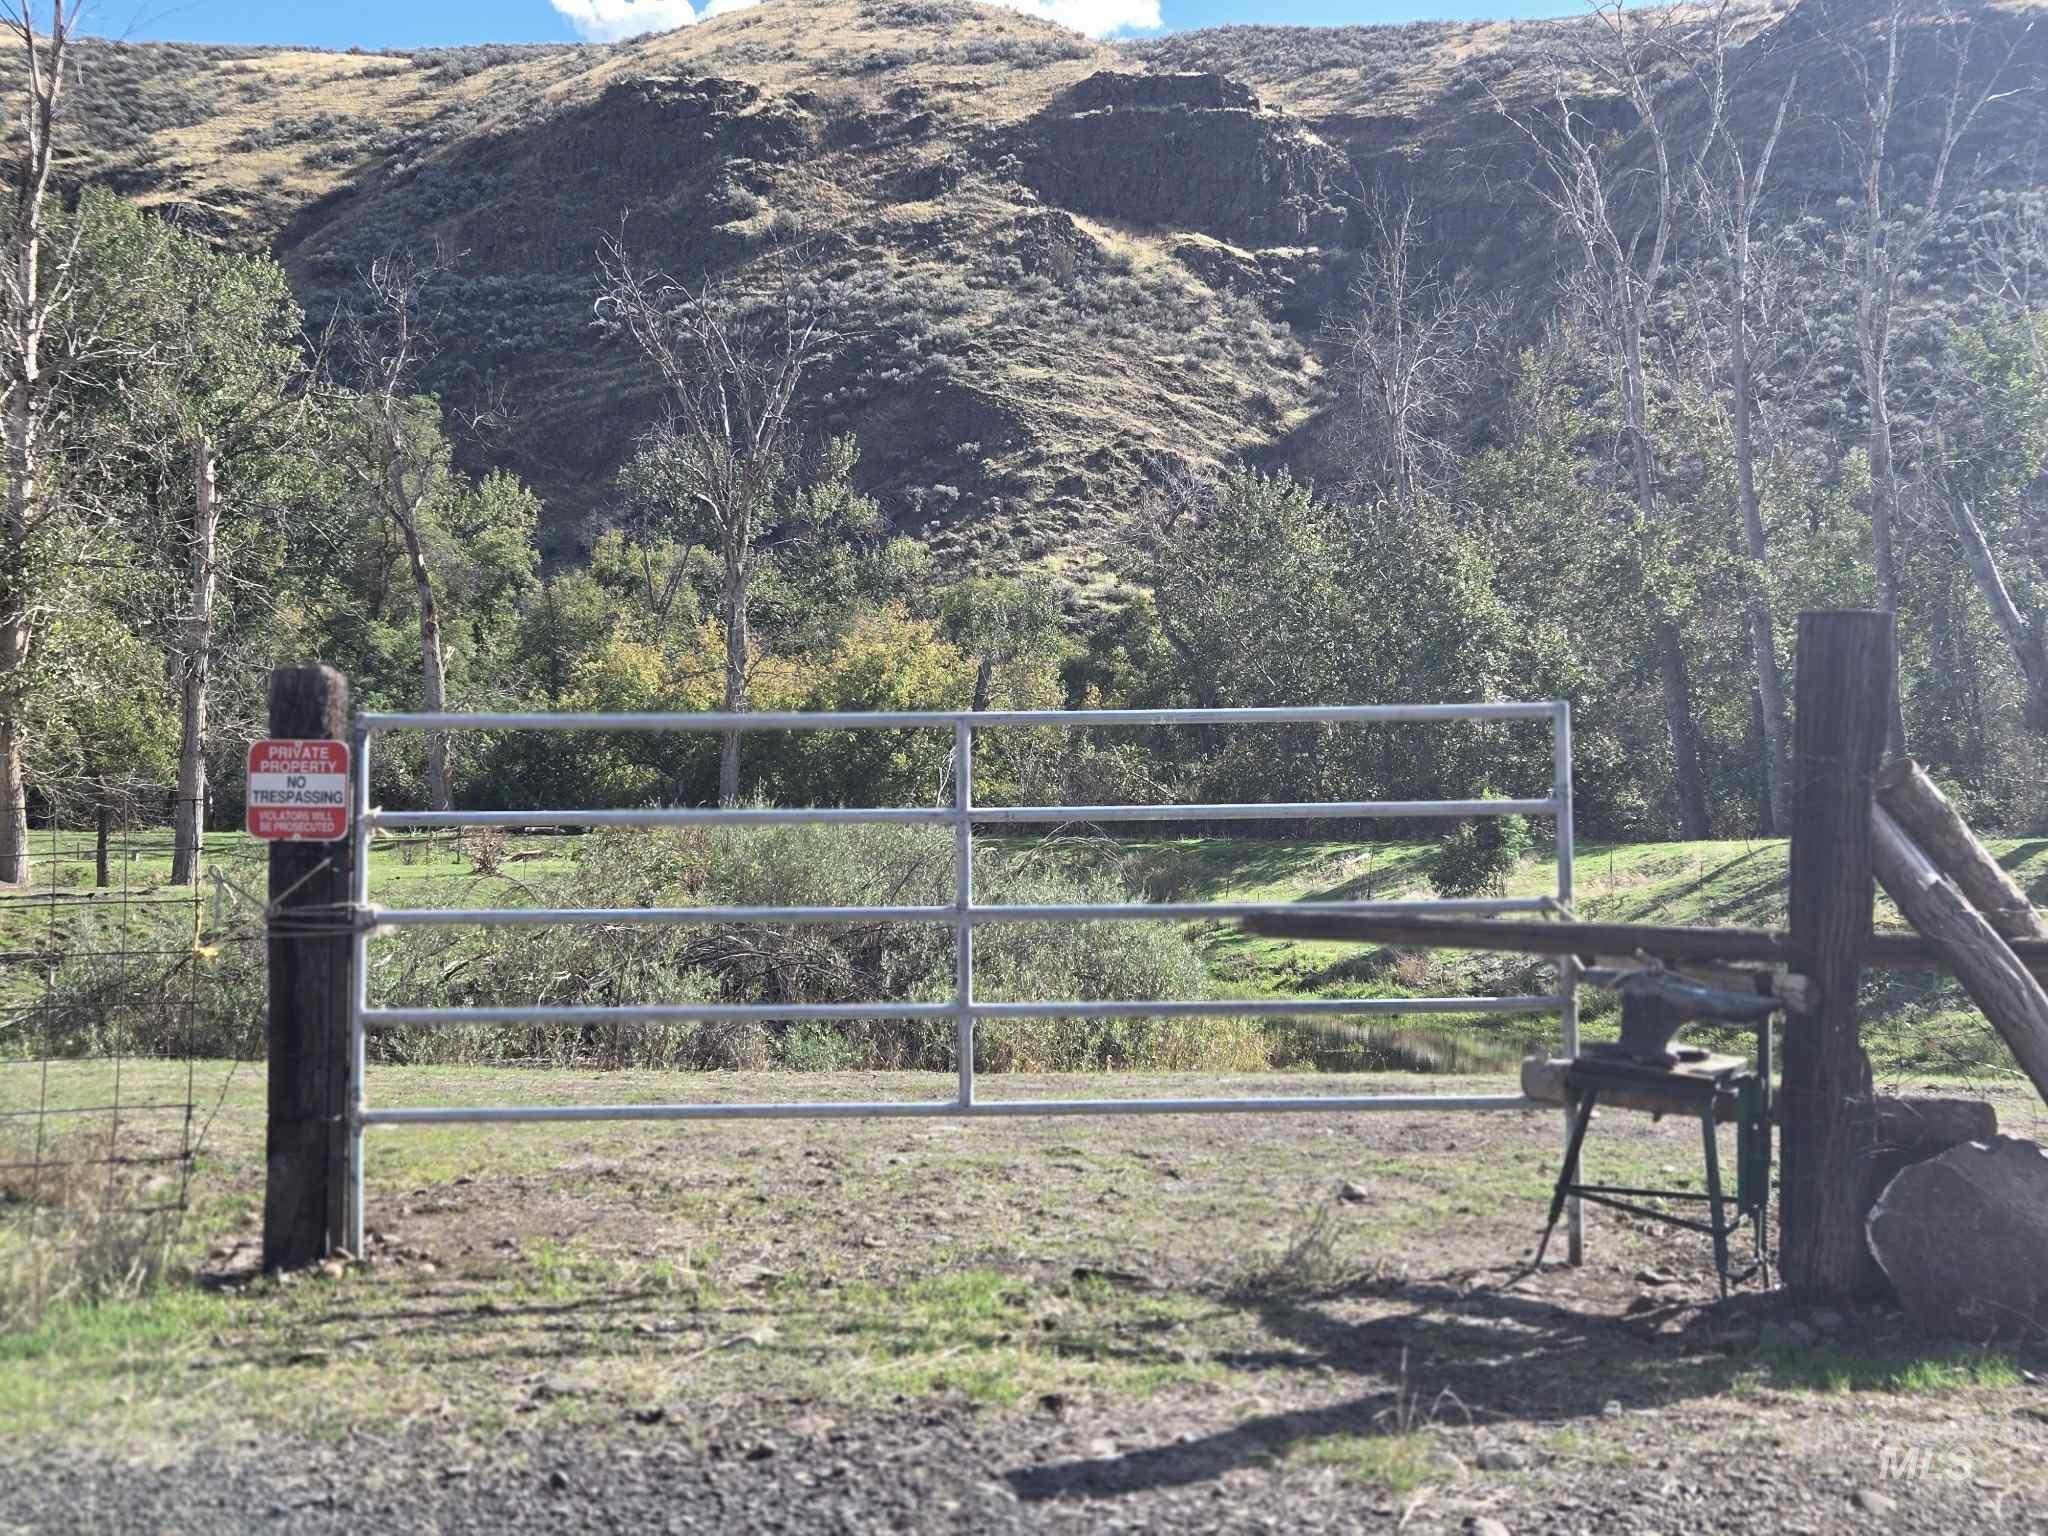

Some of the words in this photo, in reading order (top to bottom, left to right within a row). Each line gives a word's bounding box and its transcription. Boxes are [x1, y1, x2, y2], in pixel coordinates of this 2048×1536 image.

[268, 746, 329, 760] PRIVATE
[260, 760, 337, 773] PROPERTY
[287, 775, 306, 788] NO
[253, 790, 343, 804] TRESPASSING
[259, 810, 310, 821] VIOLATORS
[311, 810, 333, 821] WILL
[259, 822, 272, 832] BE
[273, 822, 336, 832] PROSECUTED
